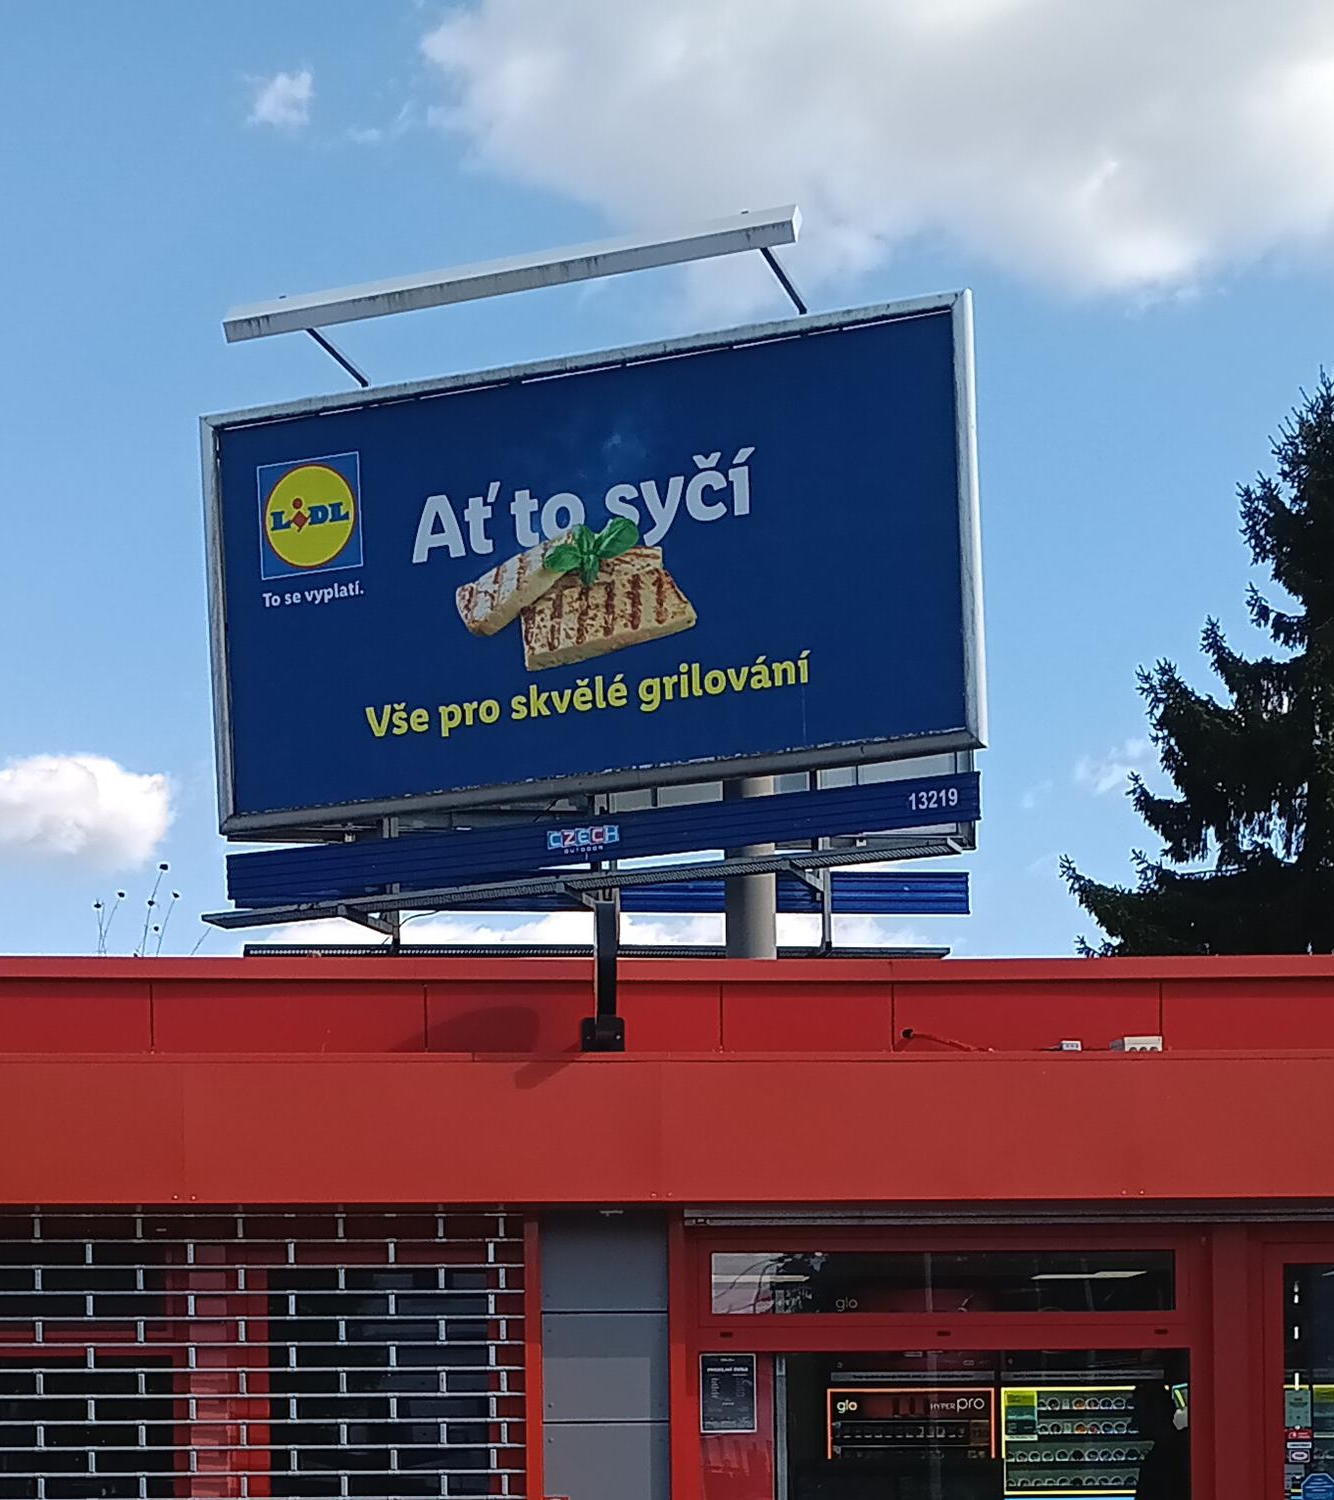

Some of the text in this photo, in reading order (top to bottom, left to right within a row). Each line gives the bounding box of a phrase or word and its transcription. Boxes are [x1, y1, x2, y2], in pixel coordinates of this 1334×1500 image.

[412, 447, 755, 563] Ať to syčí
[262, 580, 364, 607] To se vyplatí.
[365, 650, 811, 738] Vše pro skvělé grilování
[908, 788, 958, 810] 13219
[547, 825, 620, 849] CZECH
[835, 1297, 858, 1312] glo
[836, 1399, 858, 1414] glo
[956, 1398, 985, 1413] pro
